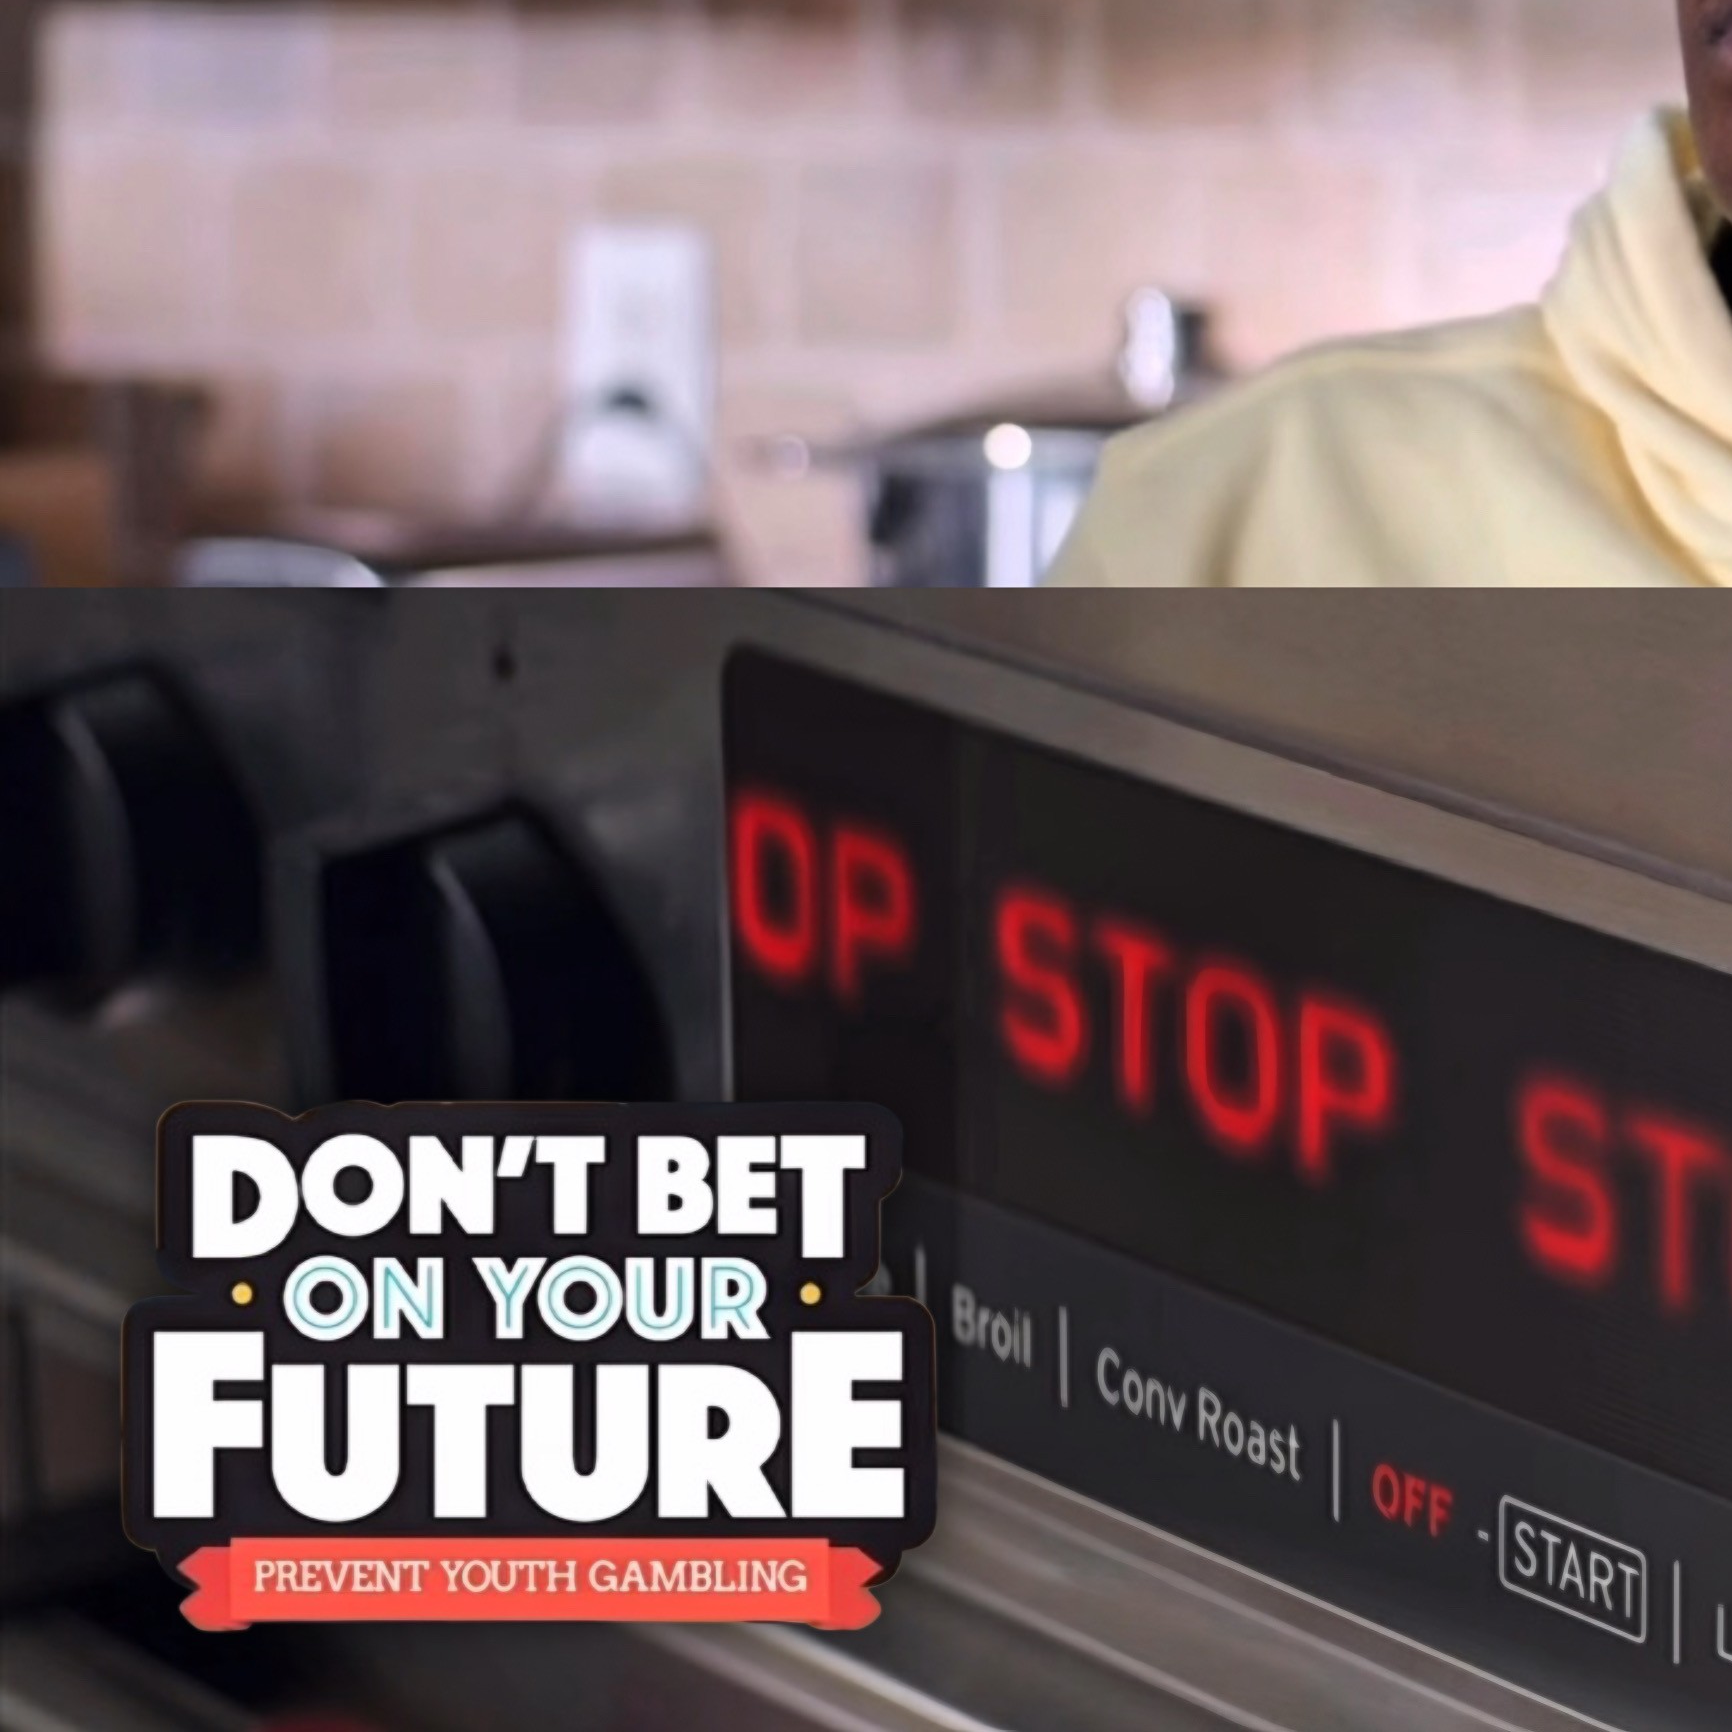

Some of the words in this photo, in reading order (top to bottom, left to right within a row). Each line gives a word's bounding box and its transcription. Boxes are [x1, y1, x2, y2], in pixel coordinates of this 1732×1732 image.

[995, 888, 1397, 1172] STOP
[951, 1282, 1033, 1369] Broil
[1096, 1346, 1186, 1432] Conv
[1198, 1386, 1301, 1482] Roast
[1372, 1463, 1452, 1536] OFF
[1513, 1519, 1640, 1619] START
